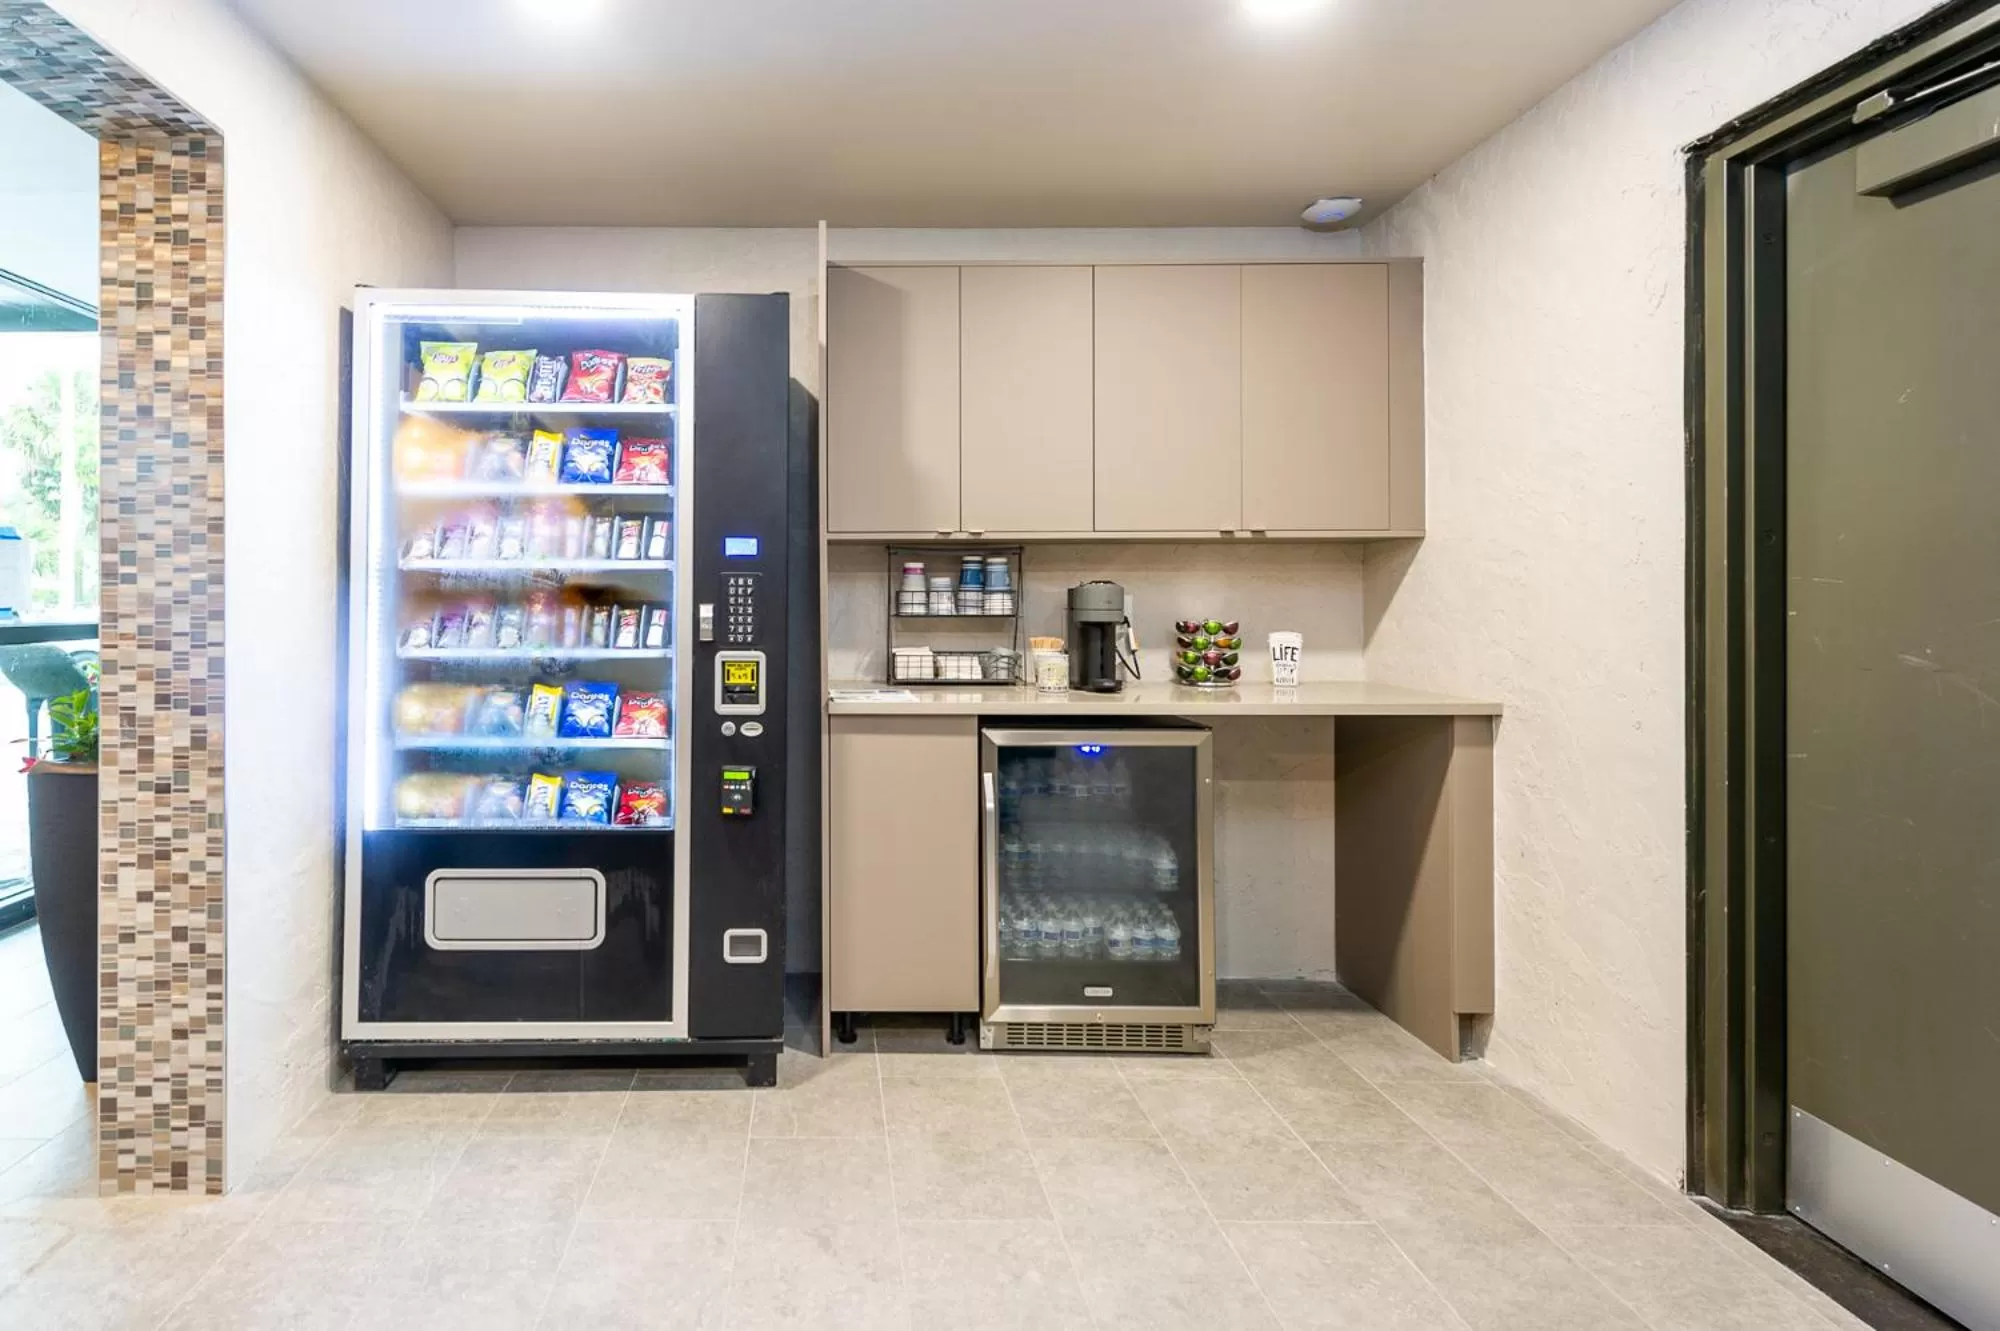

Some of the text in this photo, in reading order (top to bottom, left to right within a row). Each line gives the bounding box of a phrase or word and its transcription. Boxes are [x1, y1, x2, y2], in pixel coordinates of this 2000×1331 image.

[571, 438, 610, 449] Doritos
[571, 691, 610, 704] Doritos
[570, 780, 609, 793] Doritos
